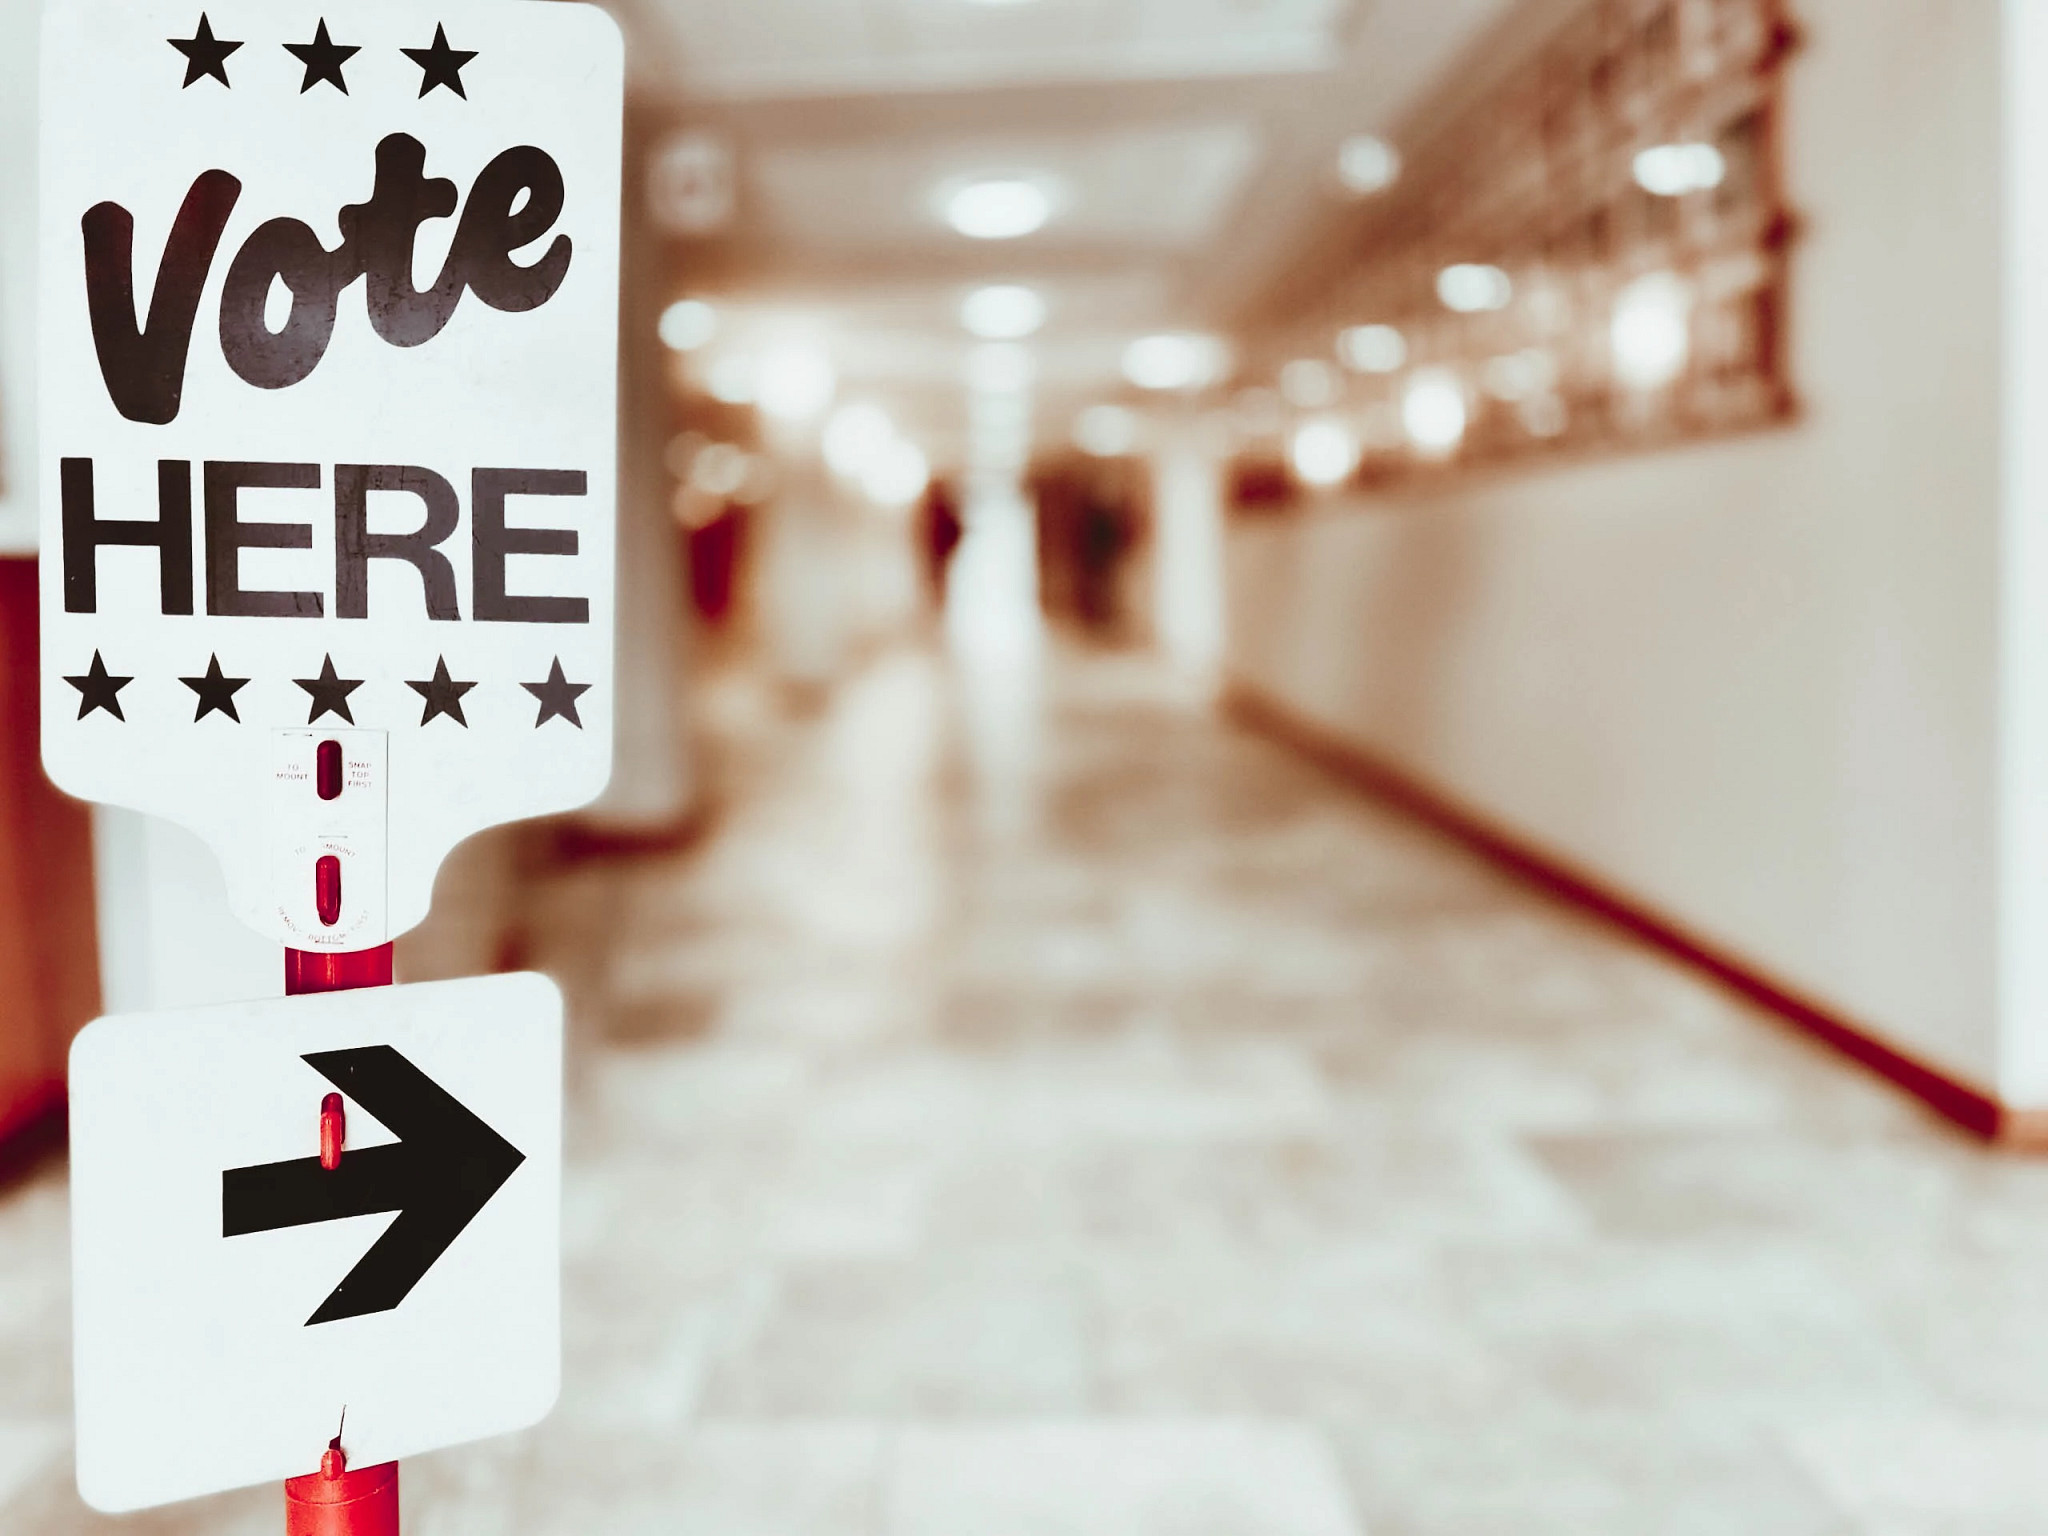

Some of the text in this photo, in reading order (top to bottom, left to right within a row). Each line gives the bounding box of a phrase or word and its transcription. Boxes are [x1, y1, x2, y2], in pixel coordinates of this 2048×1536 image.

[81, 132, 573, 425] Vote
[60, 457, 590, 623] HERE
[347, 780, 372, 788] FIRST
[348, 761, 372, 769] SNAP
